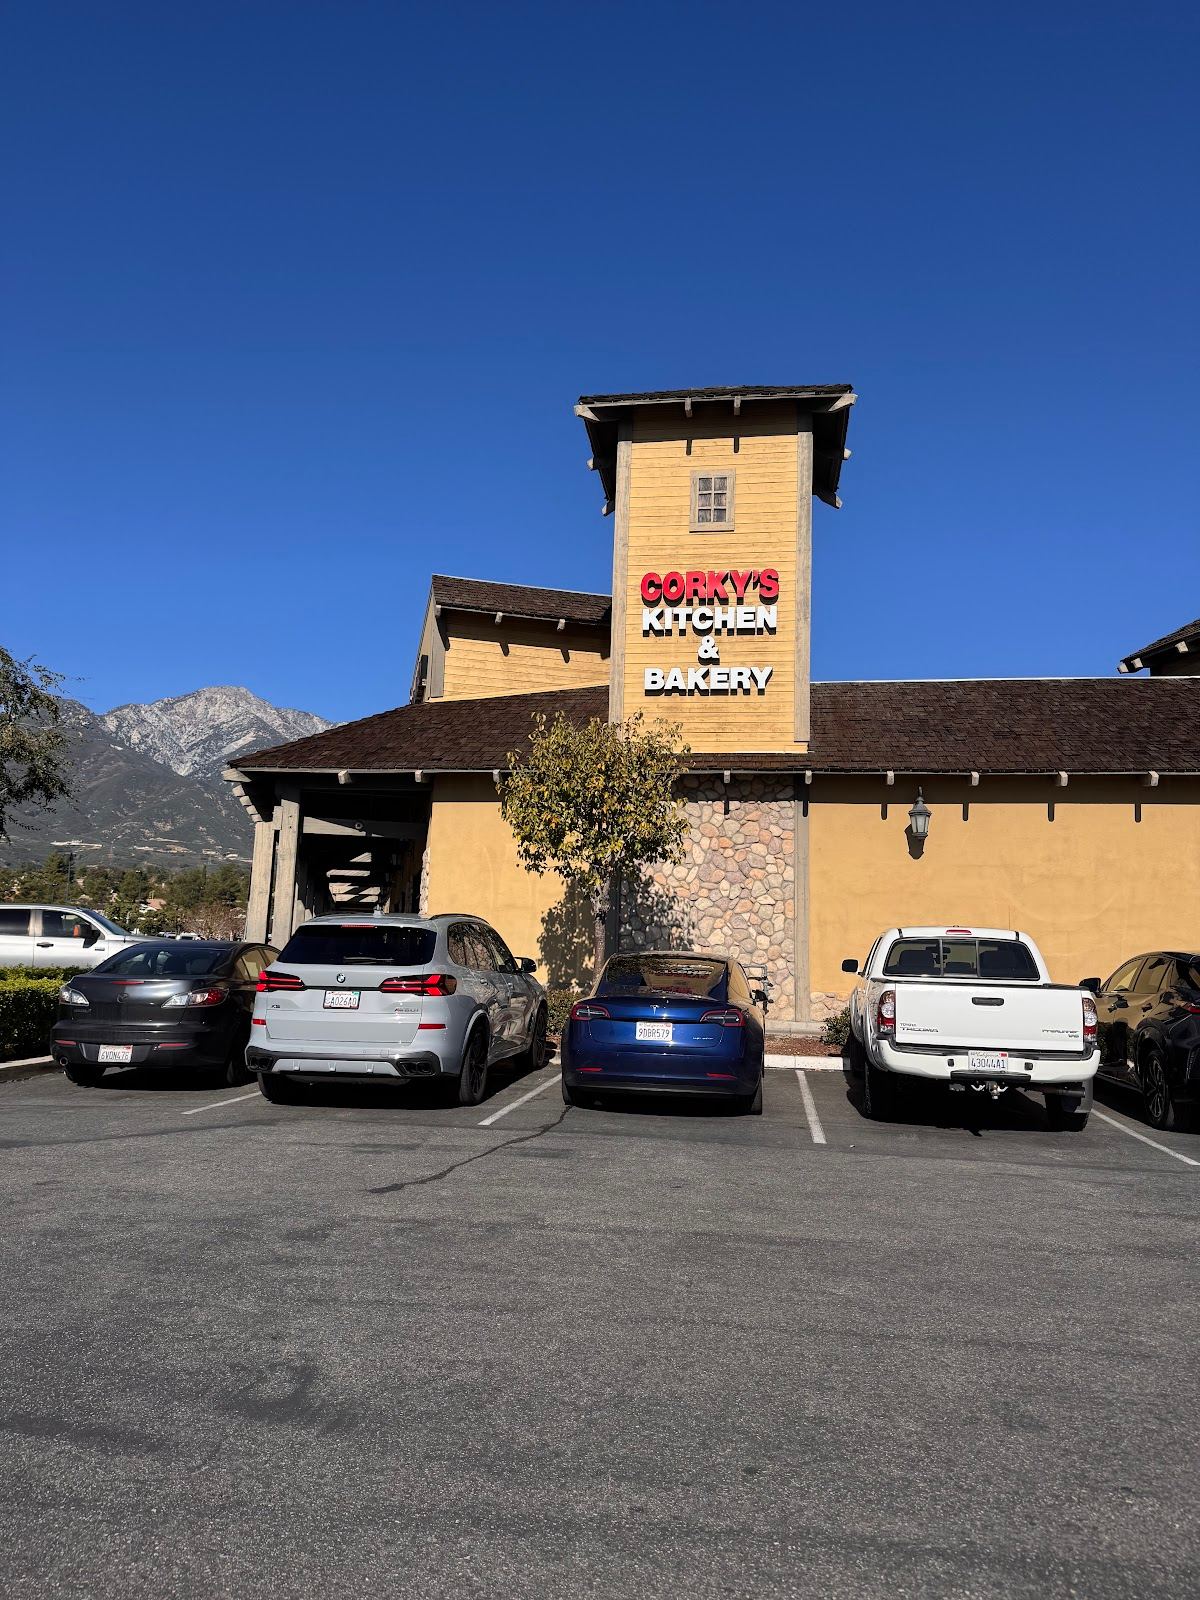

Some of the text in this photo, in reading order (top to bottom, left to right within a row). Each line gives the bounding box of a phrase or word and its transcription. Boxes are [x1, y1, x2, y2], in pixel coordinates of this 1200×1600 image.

[641, 568, 779, 602] CORKY'S
[642, 605, 777, 631] KITCHEN
[698, 635, 720, 660] &
[644, 666, 773, 690] BAKERY
[971, 1058, 1006, 1069] 43044A1
